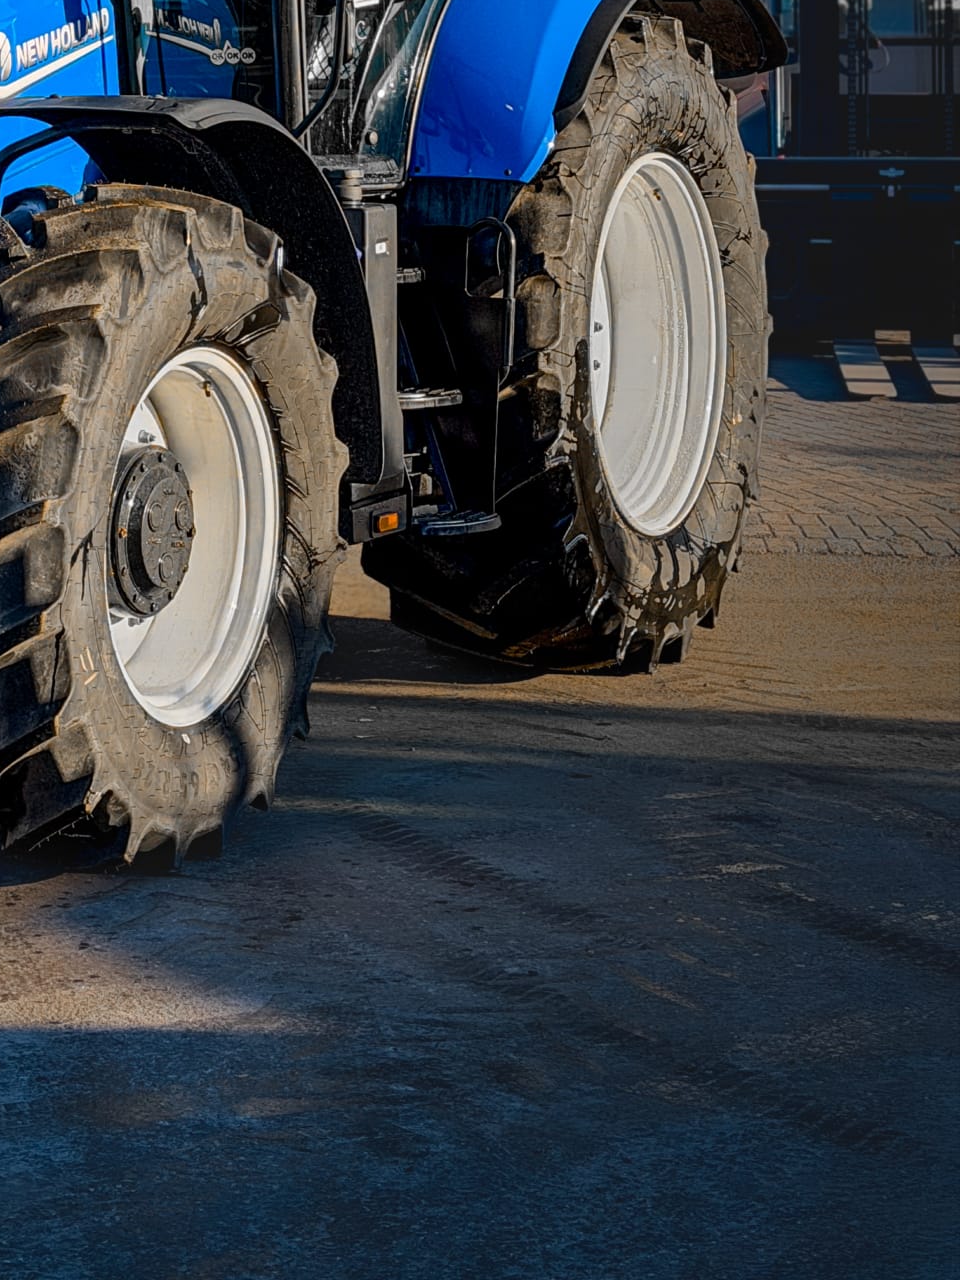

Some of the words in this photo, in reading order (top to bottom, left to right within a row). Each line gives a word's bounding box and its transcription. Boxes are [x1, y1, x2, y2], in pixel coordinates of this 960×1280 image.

[16, 33, 49, 72] NEW
[50, 7, 110, 57] HOLLAND
[211, 51, 225, 61] OK
[226, 51, 240, 61] OK
[241, 51, 255, 61] OK
